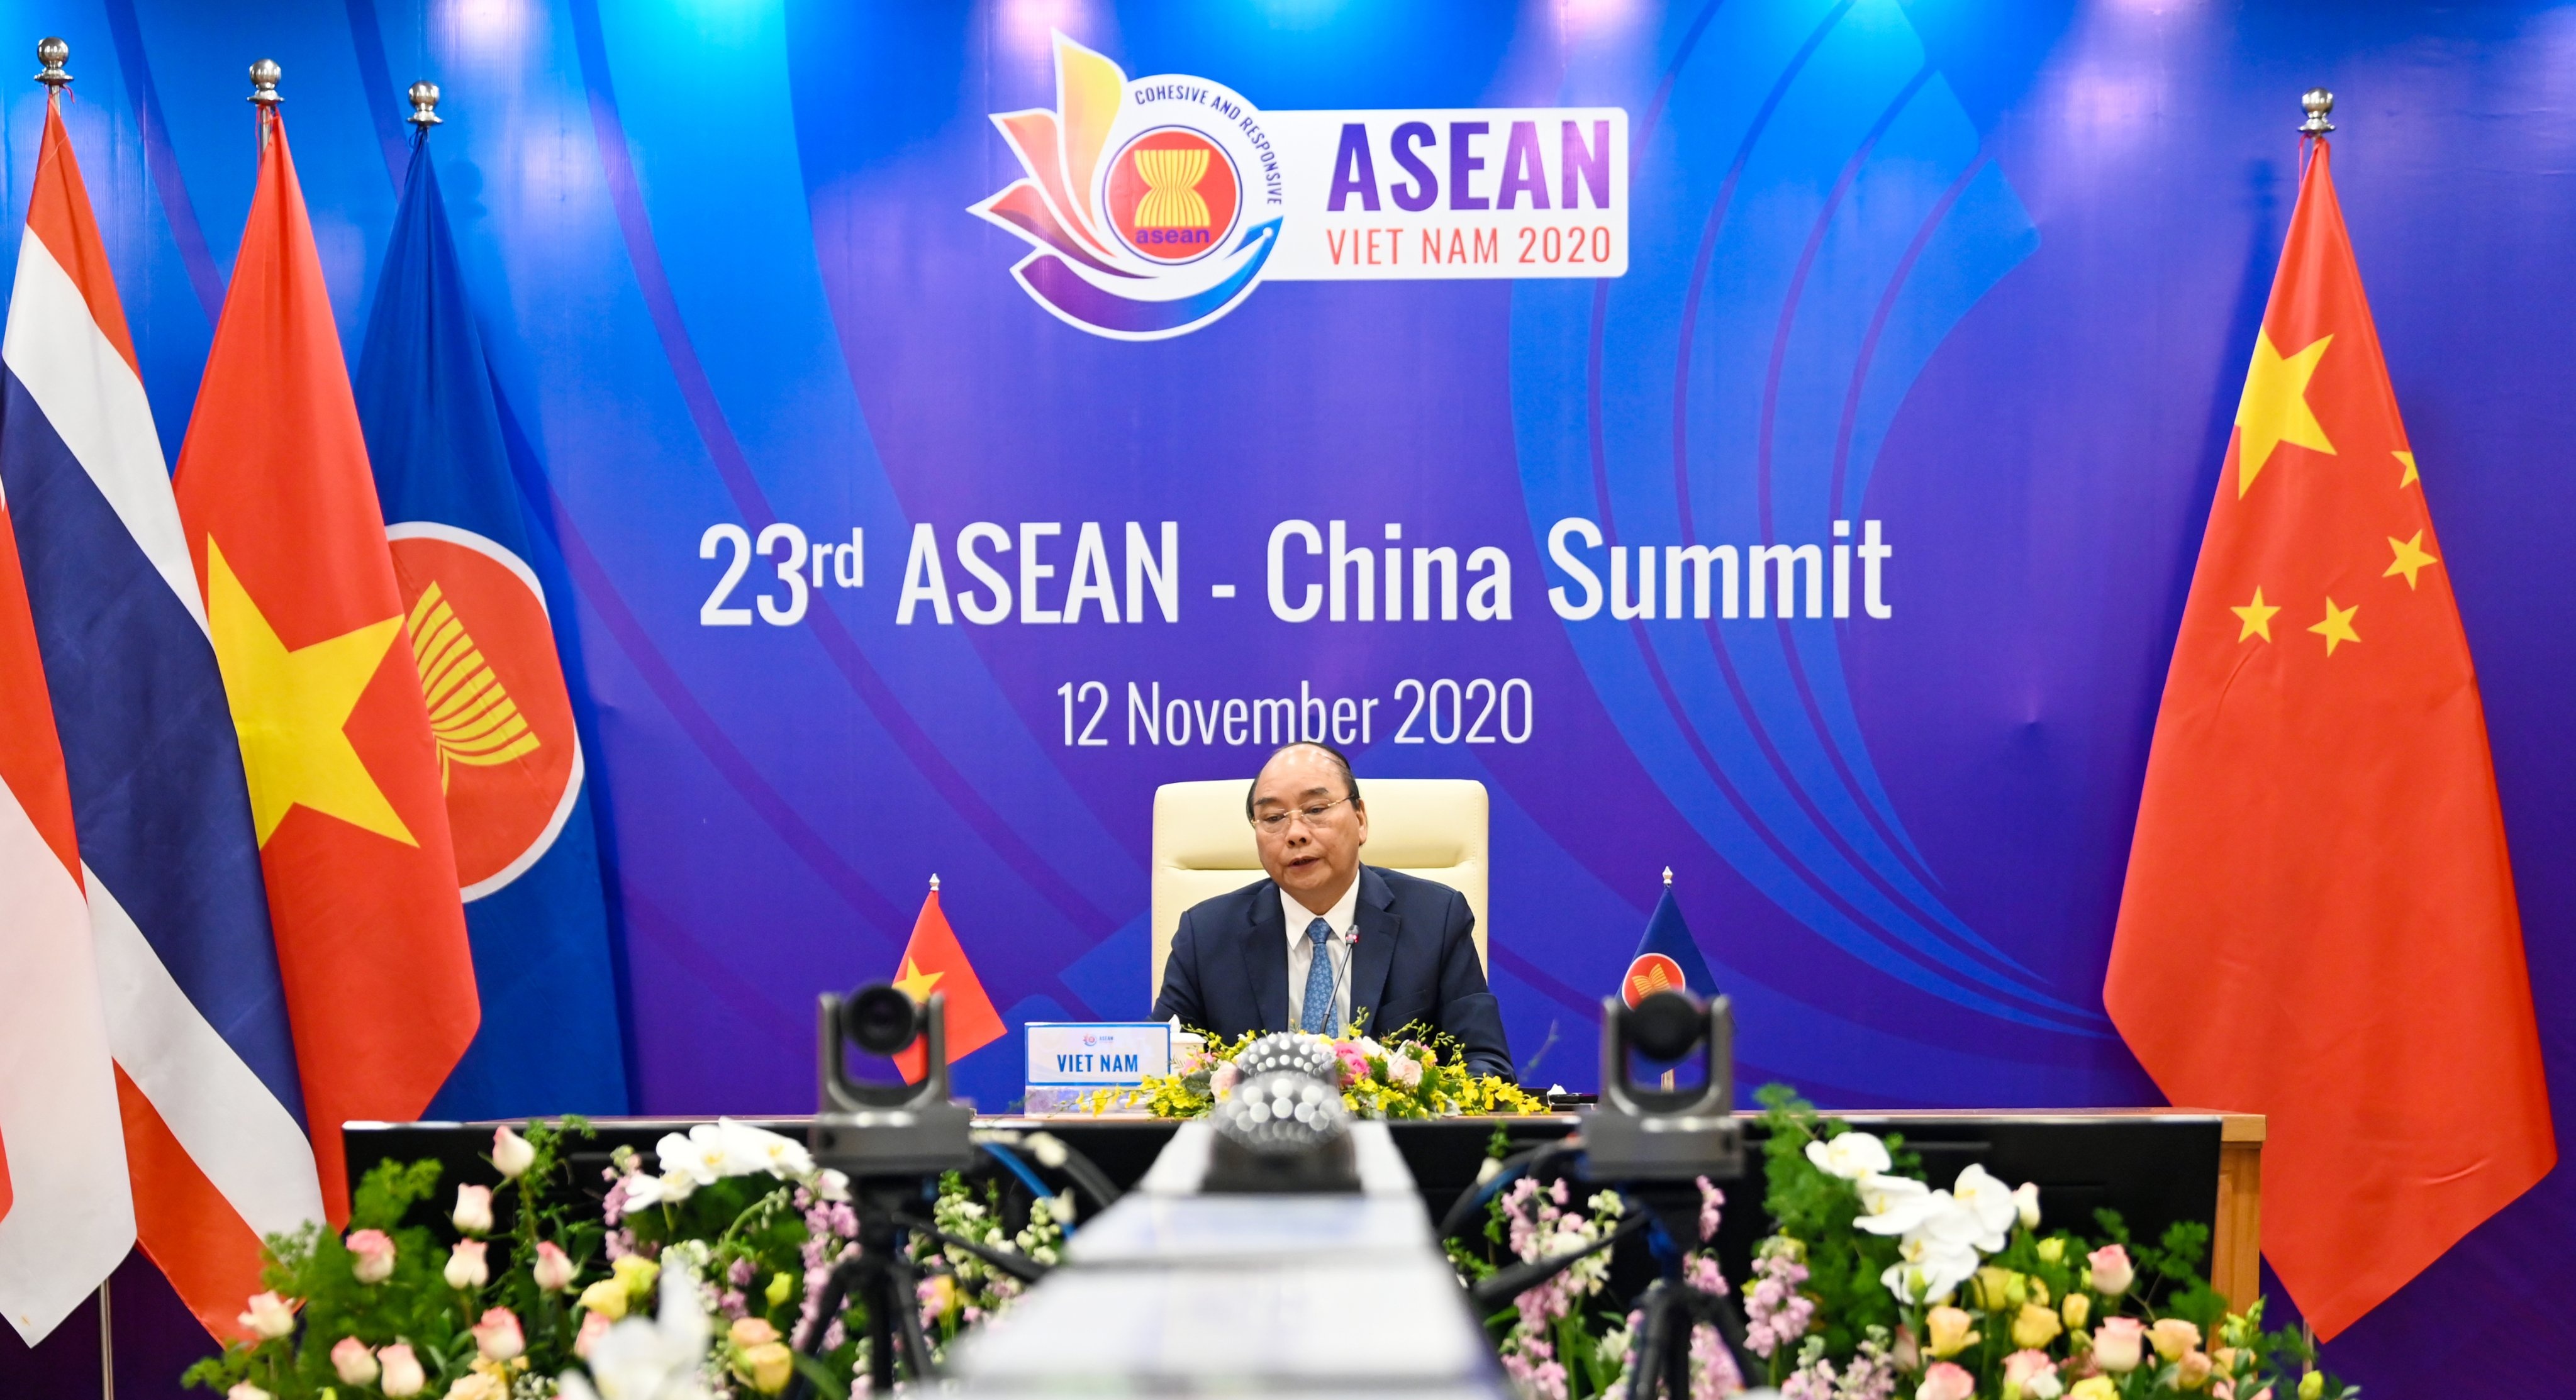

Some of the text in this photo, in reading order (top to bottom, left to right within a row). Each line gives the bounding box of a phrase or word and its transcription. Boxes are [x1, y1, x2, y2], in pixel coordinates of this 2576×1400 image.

[1135, 85, 1282, 205] COHESIVE AND RESPONSIVE
[1326, 119, 1610, 212] ASEAN
[1135, 229, 1210, 244] asean
[1326, 226, 1611, 265] VIET NAM 2020
[700, 522, 864, 626] 23rd
[895, 521, 1179, 625] ASEAN
[1267, 519, 1512, 623] China
[1547, 517, 1892, 621] Summit
[1057, 678, 1533, 746] 12 November 2020
[1057, 1054, 1138, 1072] VIET NAM
